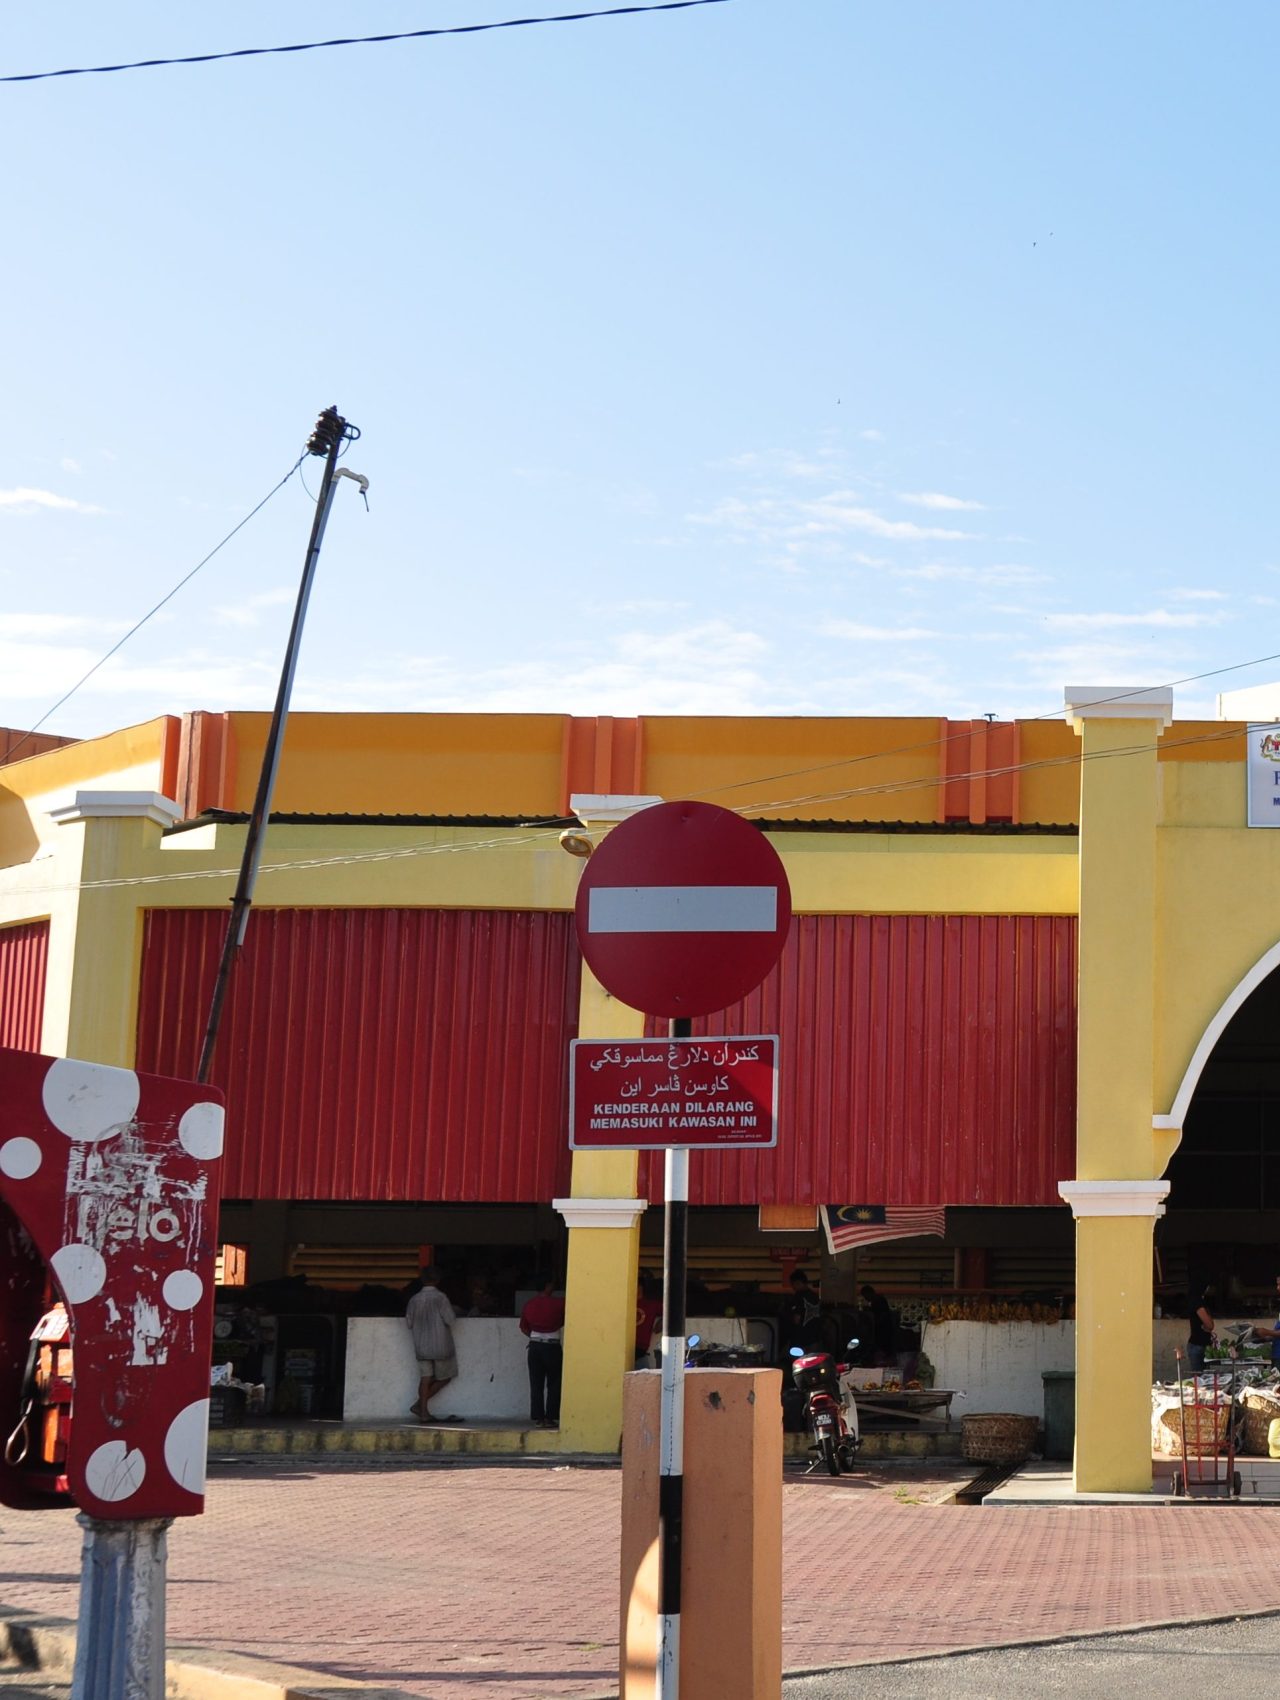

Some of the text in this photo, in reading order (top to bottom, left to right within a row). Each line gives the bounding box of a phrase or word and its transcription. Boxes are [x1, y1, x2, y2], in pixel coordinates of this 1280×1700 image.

[594, 1101, 754, 1114] KENDERAAN DILARANG
[590, 1115, 757, 1129] MEMASUKI KAWASAN INI
